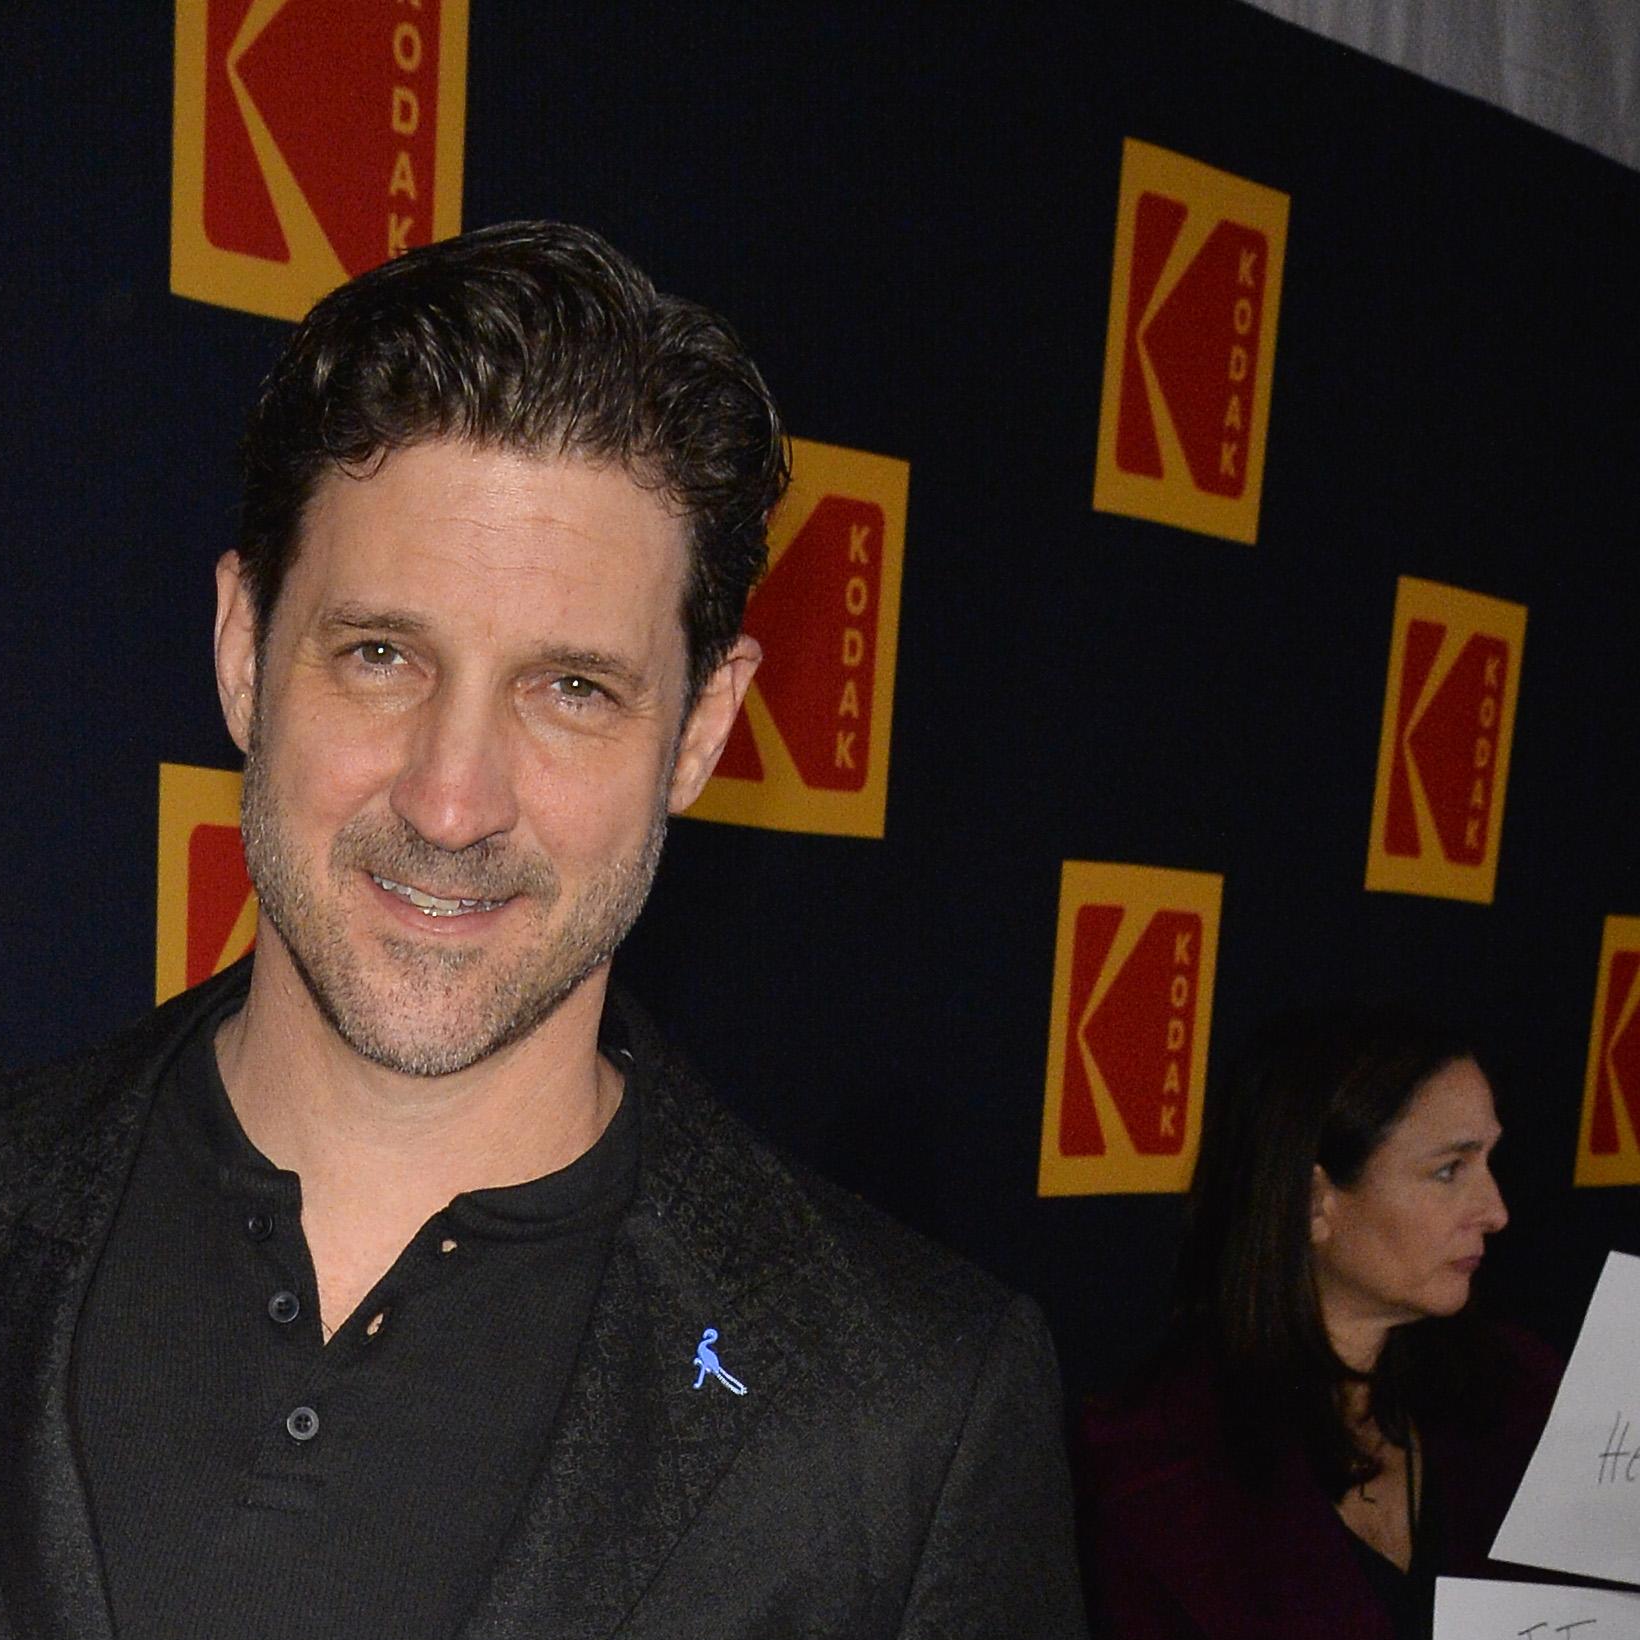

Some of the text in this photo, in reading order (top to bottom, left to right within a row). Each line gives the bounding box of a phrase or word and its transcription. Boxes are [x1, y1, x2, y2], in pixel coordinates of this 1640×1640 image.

[387, 0, 423, 260] ODAK
[1220, 250, 1258, 478] KODAK
[834, 523, 870, 770] KODAK
[1465, 655, 1500, 849] KODAK
[1159, 931, 1193, 1138] KODAK
